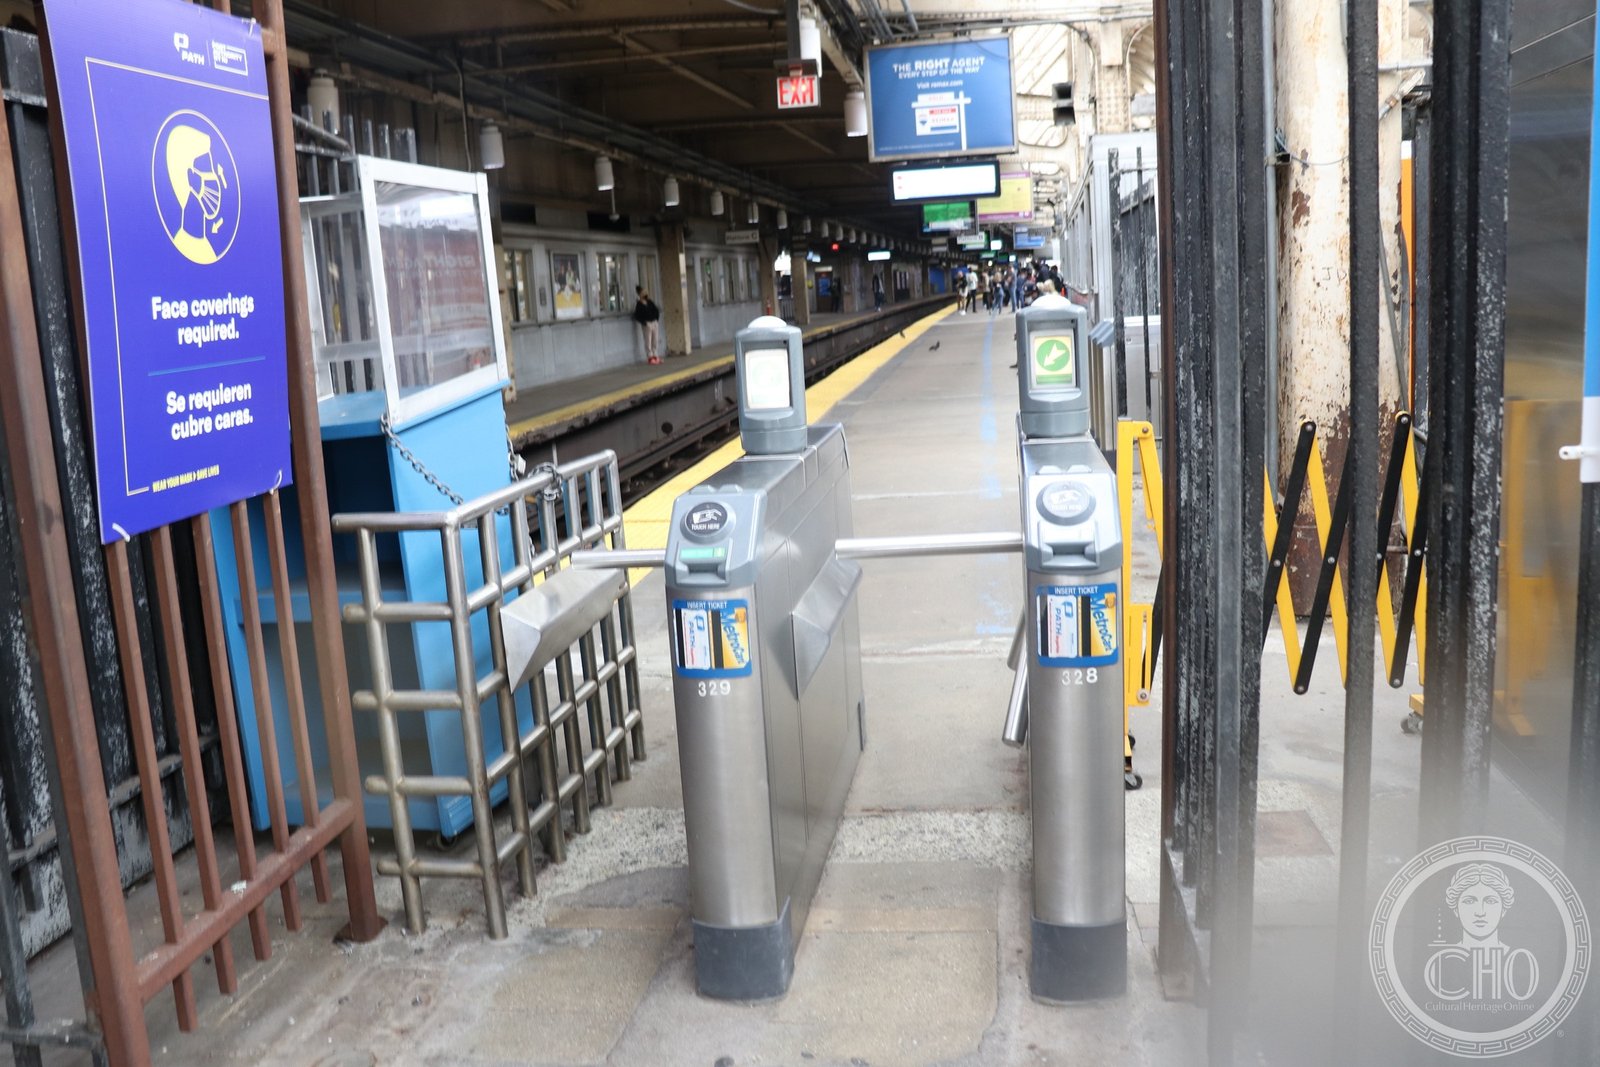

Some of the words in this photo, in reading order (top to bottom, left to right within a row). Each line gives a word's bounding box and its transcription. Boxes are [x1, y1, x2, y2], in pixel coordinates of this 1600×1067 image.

[892, 63, 911, 72] THE
[914, 58, 950, 70] RIGHT
[952, 56, 985, 67] AGENT
[899, 70, 920, 79] EVERY
[921, 69, 937, 77] STEP
[951, 67, 963, 75] THE
[778, 77, 816, 105] EXIT
[152, 296, 188, 320] Face
[191, 292, 254, 318] coverings
[178, 317, 240, 348] required.
[166, 391, 186, 415] Se
[188, 382, 252, 412] requieren
[171, 414, 212, 440] cubre
[215, 408, 254, 431] caras.
[1054, 586, 1076, 594] INSERT
[686, 601, 706, 609] INSERT
[708, 601, 728, 609] TICKET
[1061, 667, 1098, 686] 328
[698, 679, 731, 697] 329
